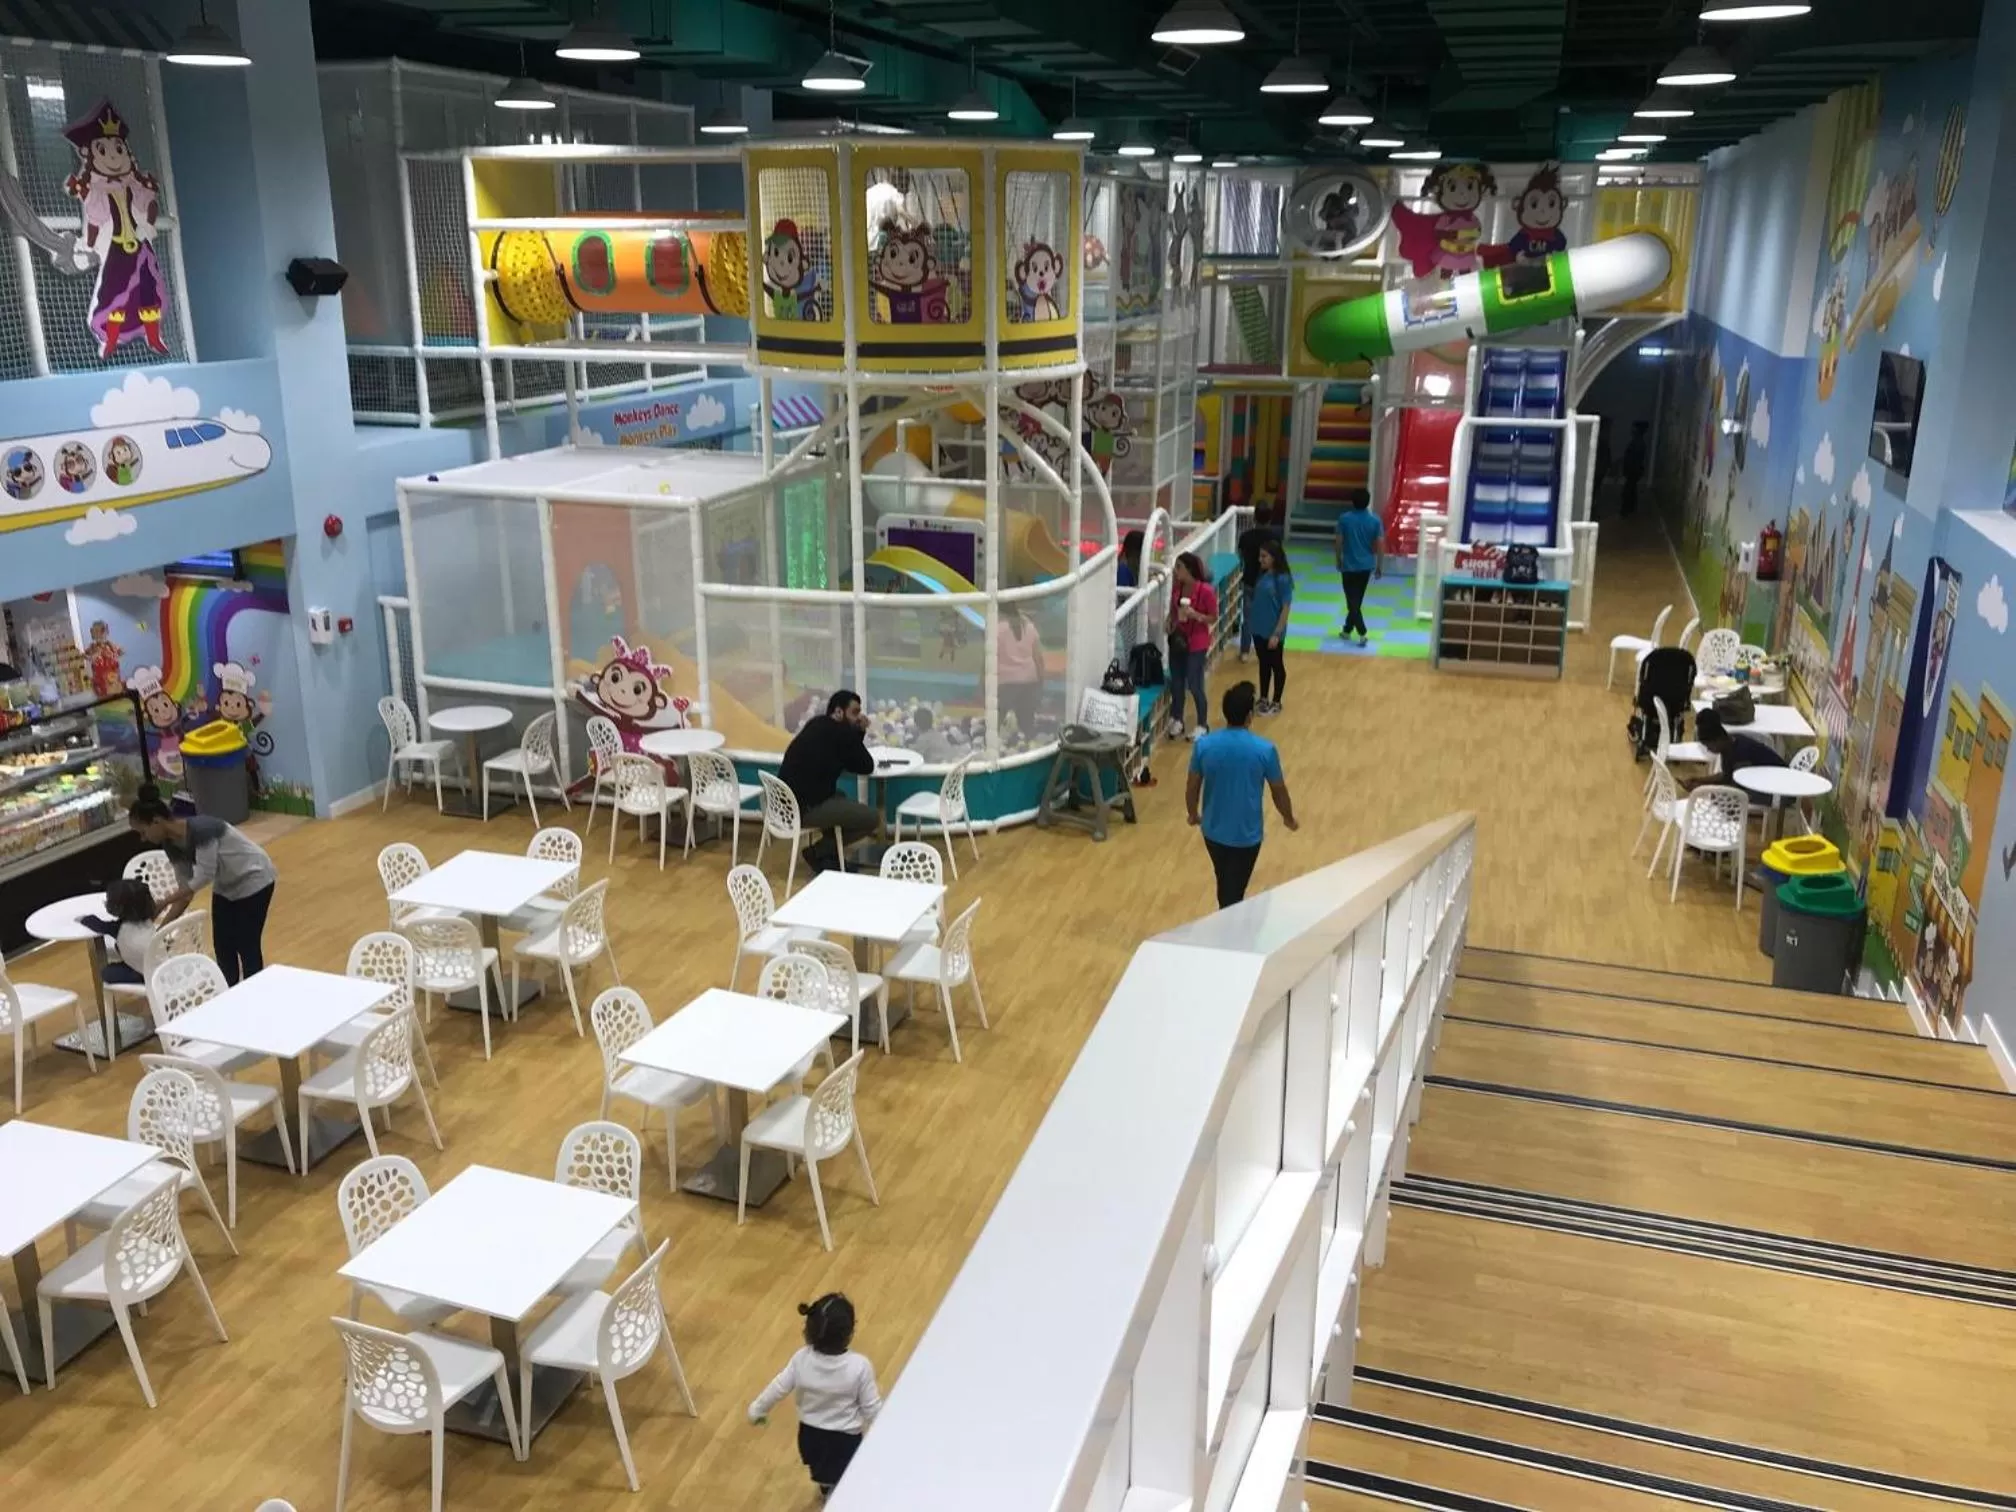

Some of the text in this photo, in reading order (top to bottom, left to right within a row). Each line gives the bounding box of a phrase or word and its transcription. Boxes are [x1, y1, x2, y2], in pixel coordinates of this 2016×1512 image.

[613, 403, 679, 426] Monkeys Dance
[1461, 559, 1498, 569] SHOES
